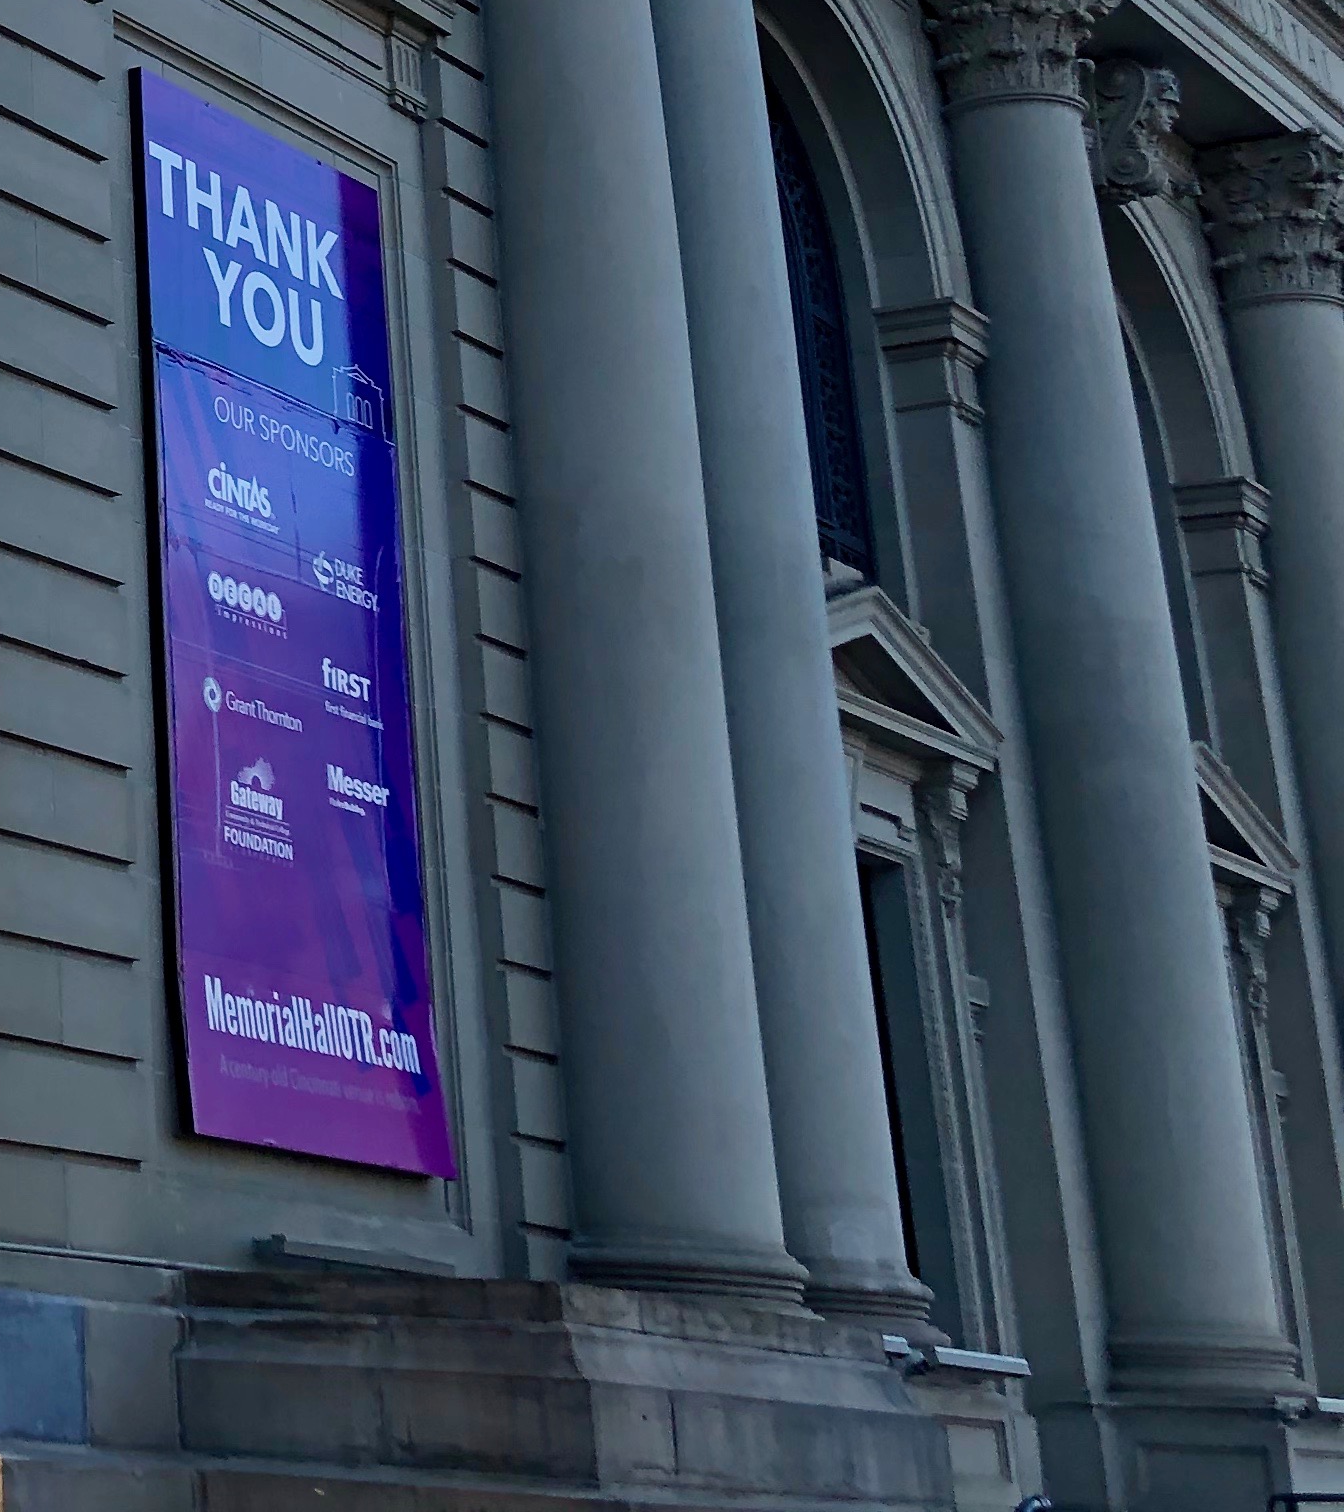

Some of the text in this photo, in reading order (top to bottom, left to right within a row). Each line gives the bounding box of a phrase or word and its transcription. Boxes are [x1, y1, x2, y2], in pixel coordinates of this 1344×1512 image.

[148, 140, 345, 301] THANK
[202, 246, 324, 367] YOU
[214, 396, 356, 477] OUR SPONSORS
[334, 557, 365, 586] DUKE
[210, 573, 281, 620] DECAL
[335, 579, 379, 612] ENERGY
[230, 779, 284, 821] Gateway
[326, 763, 390, 807] Messer
[223, 825, 294, 862] FOUNDATION
[204, 974, 422, 1075] MemorialHallOTR.com
